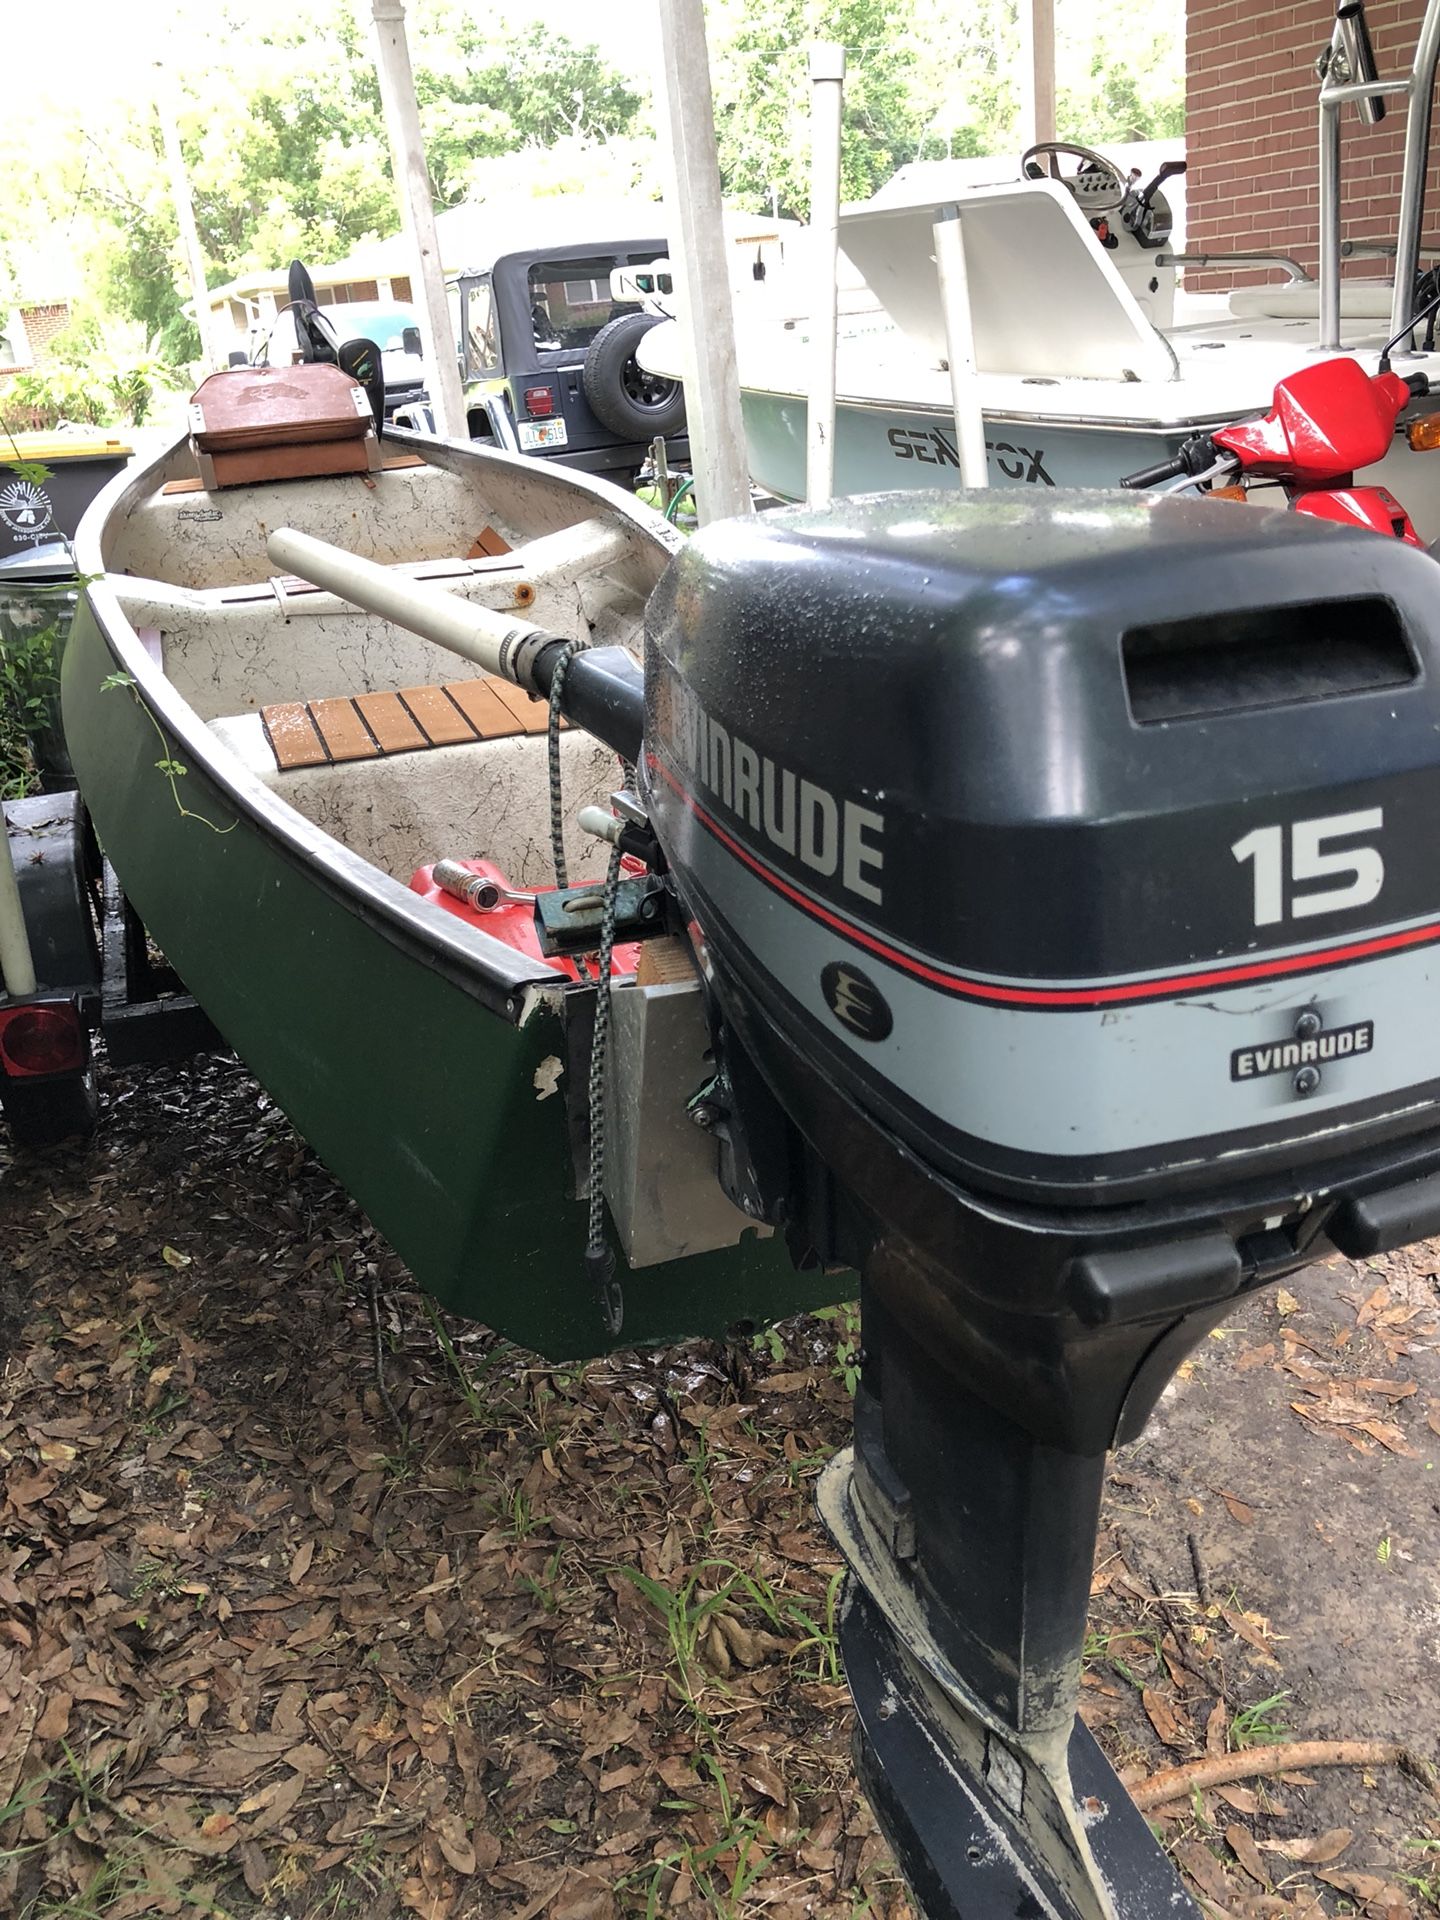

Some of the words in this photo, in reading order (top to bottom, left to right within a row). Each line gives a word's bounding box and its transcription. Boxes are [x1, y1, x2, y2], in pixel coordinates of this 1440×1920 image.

[985, 442, 1056, 486] OX
[1231, 807, 1385, 926] 15
[1237, 1027, 1370, 1077] EVINRUDE
